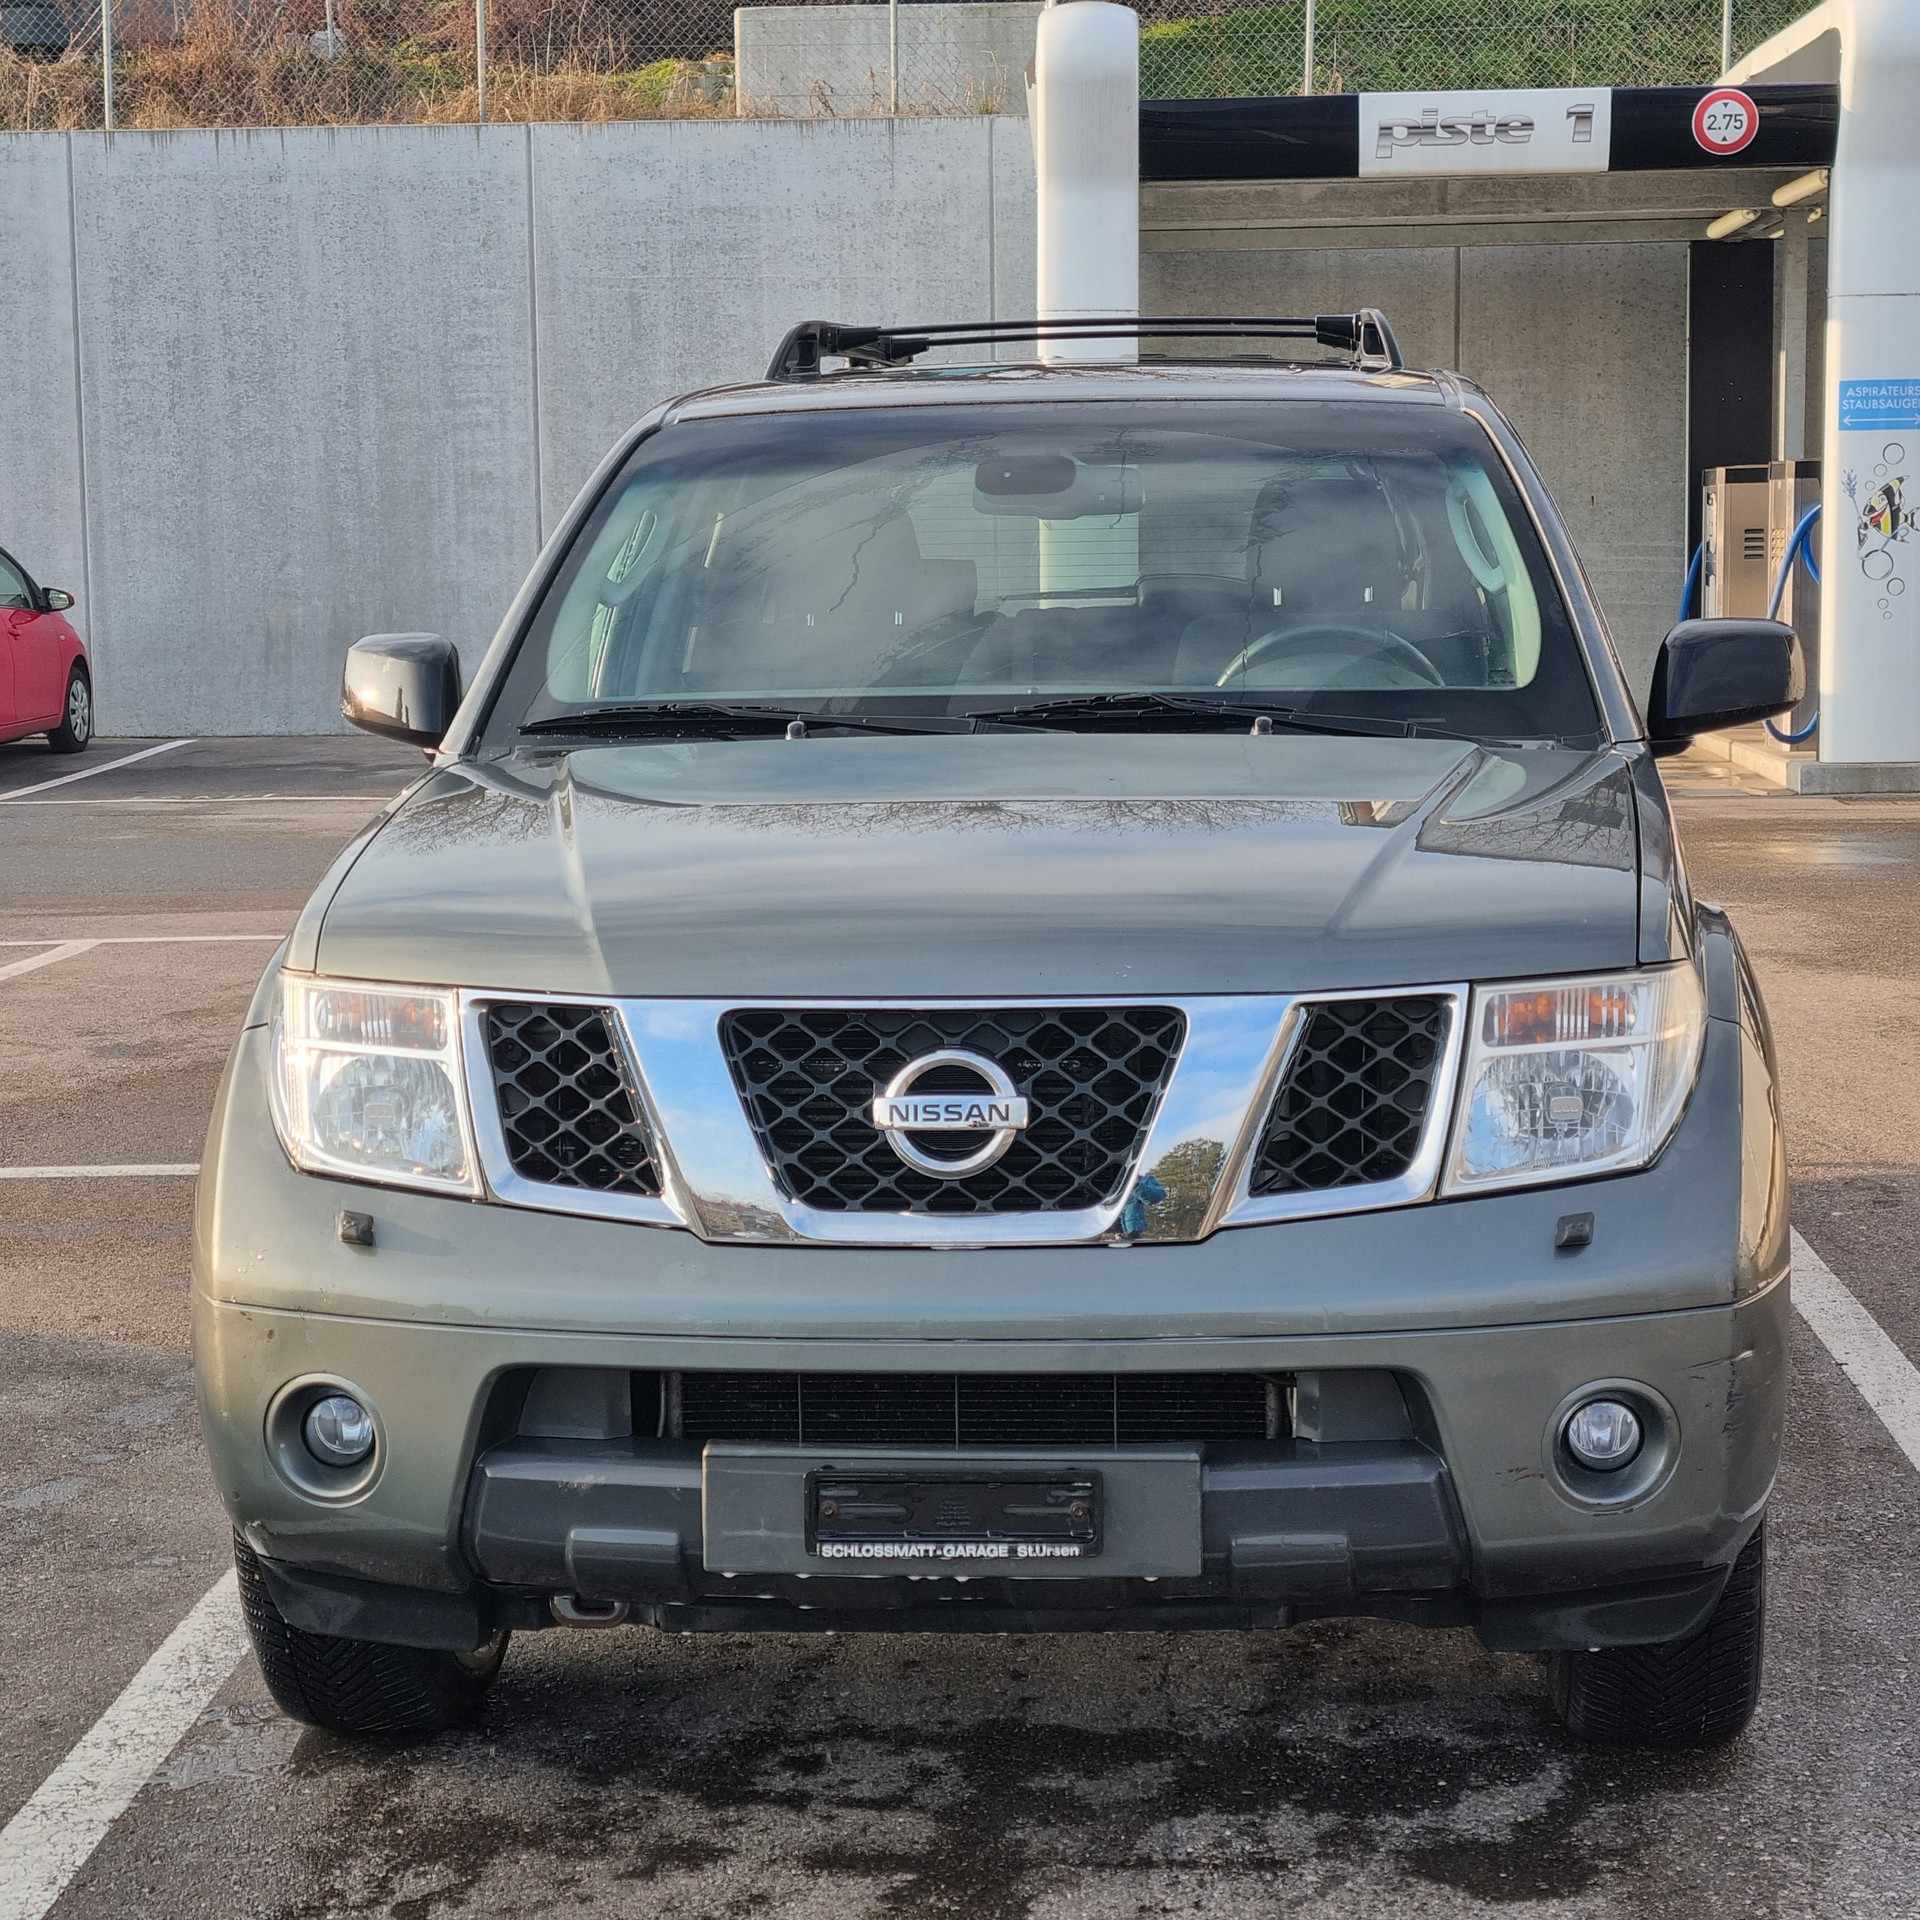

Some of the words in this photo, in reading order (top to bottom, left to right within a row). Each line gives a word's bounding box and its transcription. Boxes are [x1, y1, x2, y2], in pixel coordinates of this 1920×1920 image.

[1707, 113, 1744, 130] 2.75
[1376, 108, 1535, 158] piste
[1566, 103, 1595, 143] 1
[1846, 385, 1920, 398] ASPIRATEURS
[1842, 398, 1920, 410] STAUBSAUGE
[889, 1104, 1010, 1122] NISSAN
[821, 1543, 1009, 1558] SCHLOSSMATT-GARAGE
